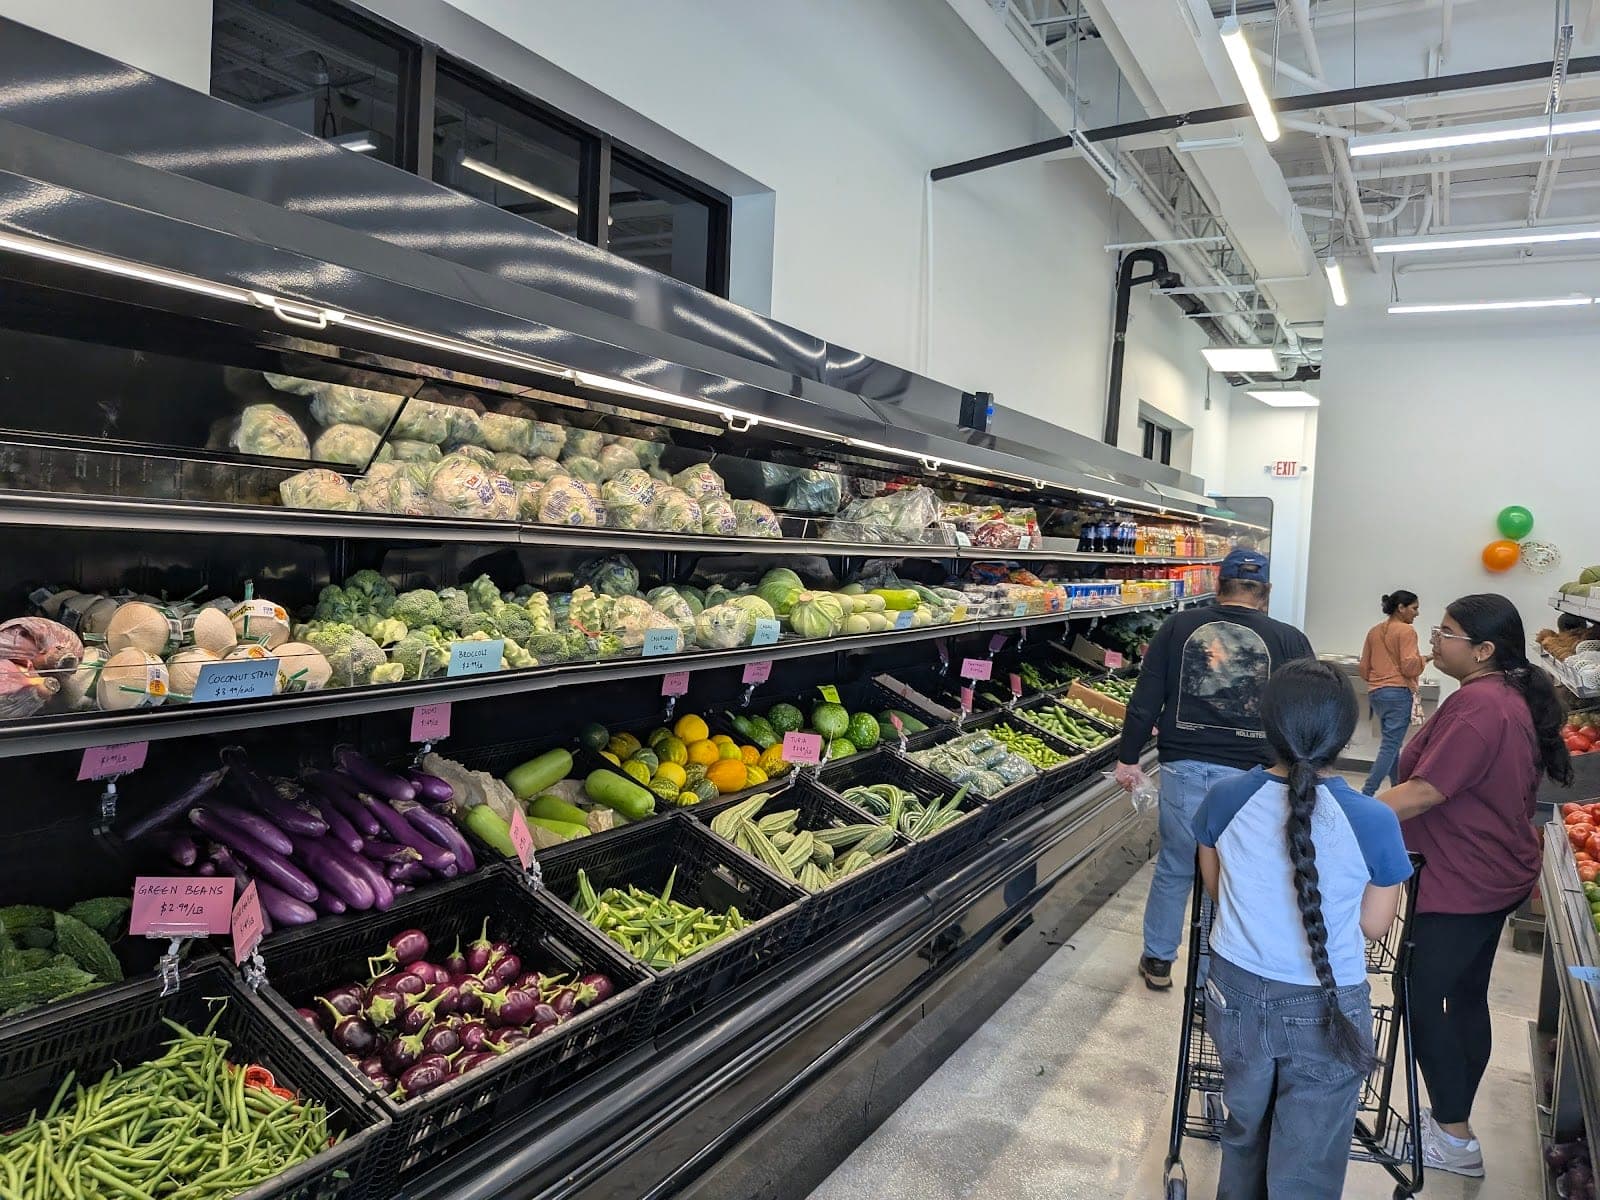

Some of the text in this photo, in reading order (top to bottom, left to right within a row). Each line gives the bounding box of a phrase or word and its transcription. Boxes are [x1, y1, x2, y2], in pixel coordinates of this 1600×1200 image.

[1276, 461, 1297, 475] EXIT
[458, 649, 488, 659] BROCCOLI
[207, 673, 249, 685] COCONUT
[138, 885, 223, 896] GREEN BEANS
